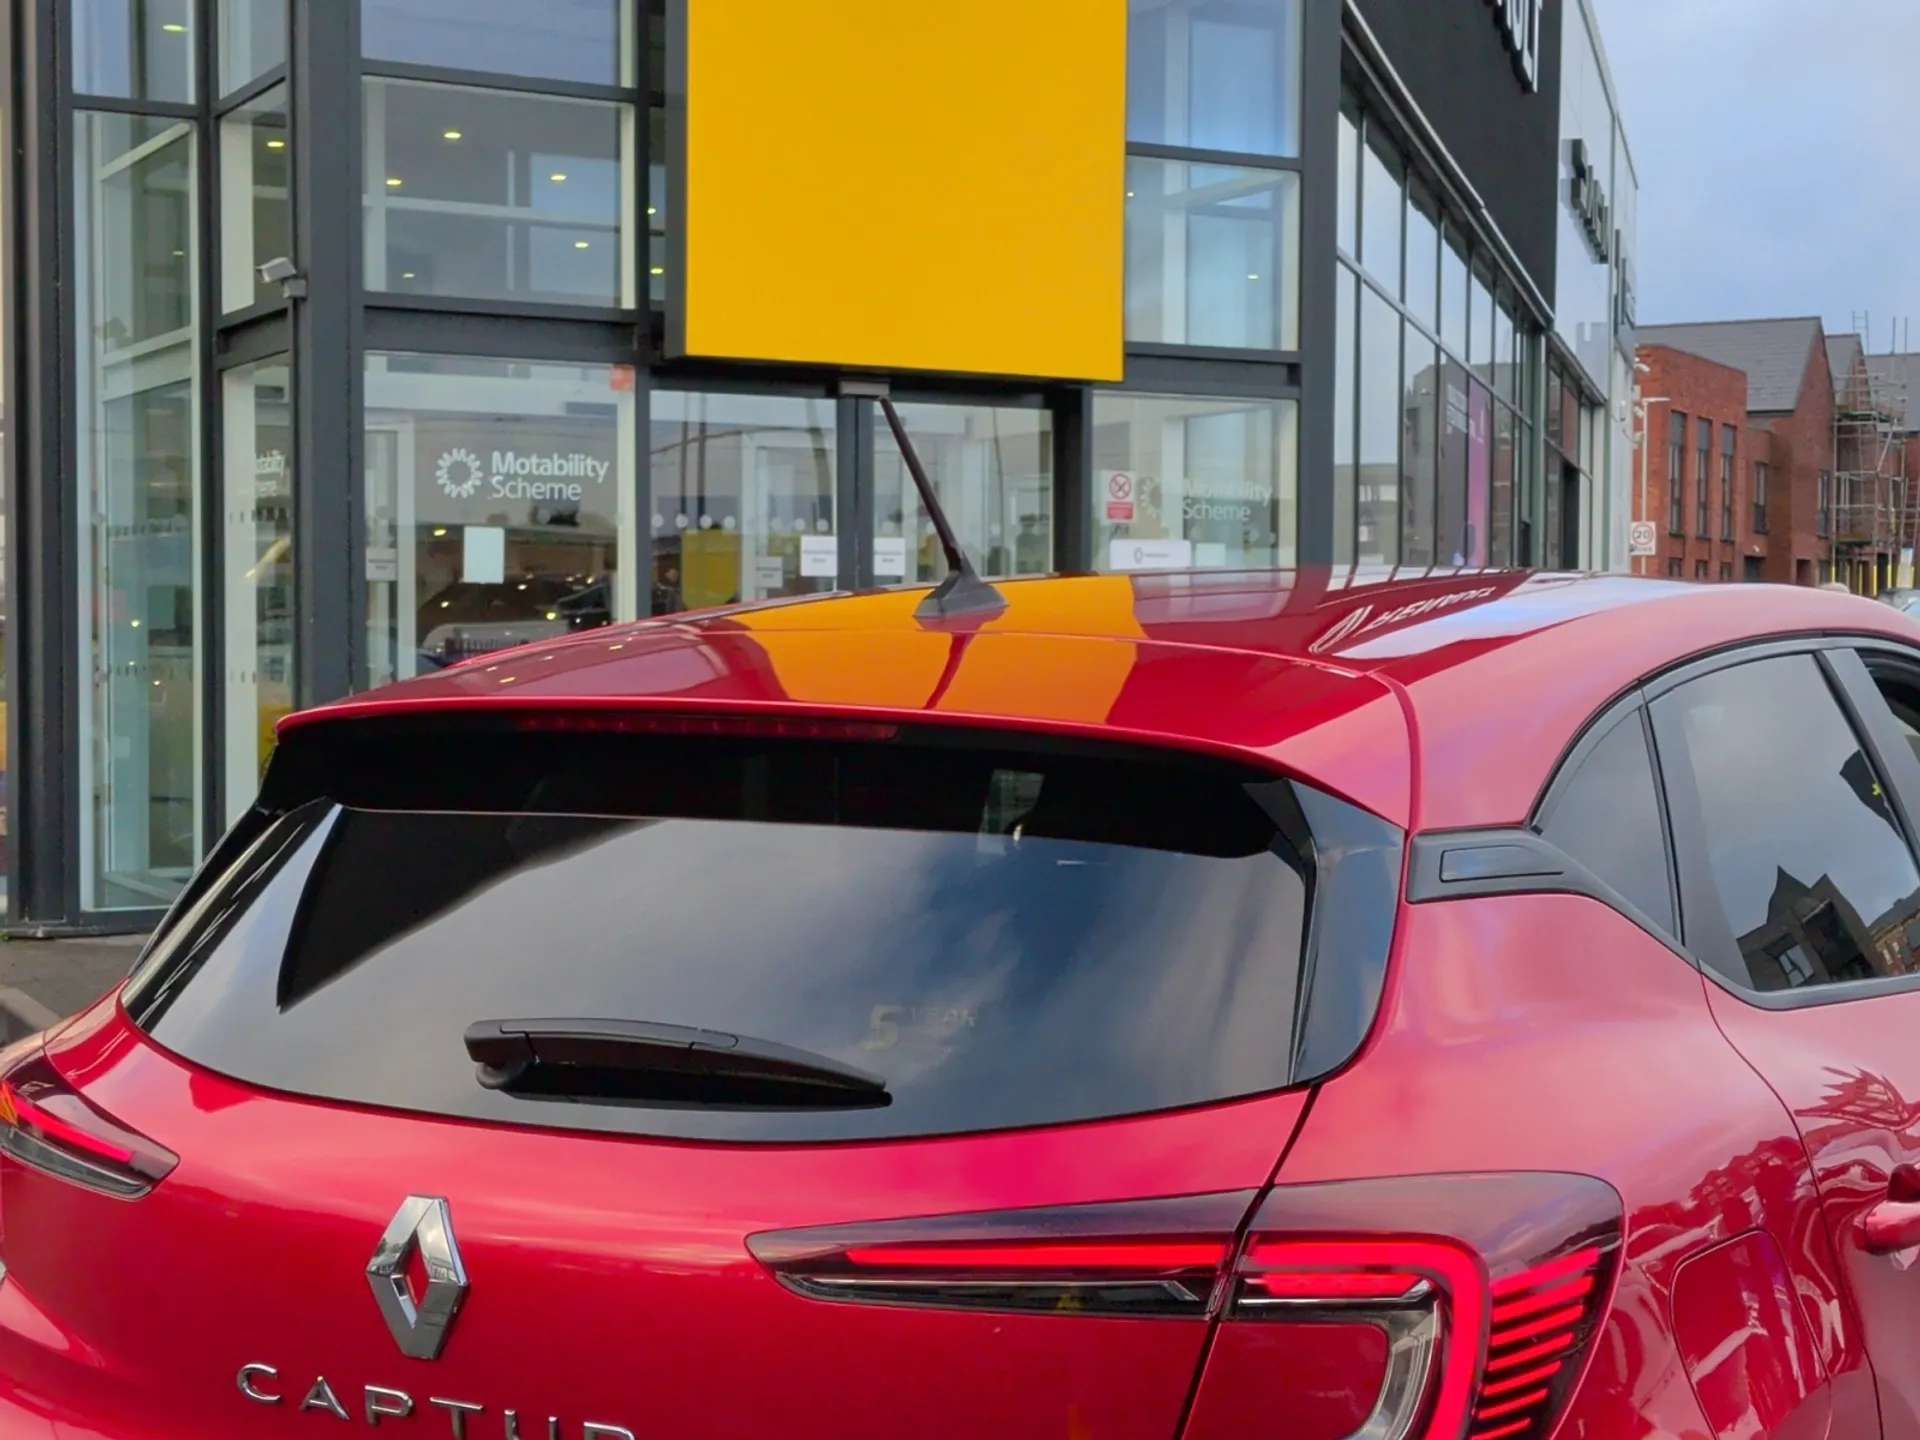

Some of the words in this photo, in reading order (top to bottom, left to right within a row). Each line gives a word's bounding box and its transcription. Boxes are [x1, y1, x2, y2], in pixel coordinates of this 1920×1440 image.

[491, 450, 610, 484] Motability
[491, 475, 582, 501] Scheme
[1183, 498, 1251, 522] Scheme
